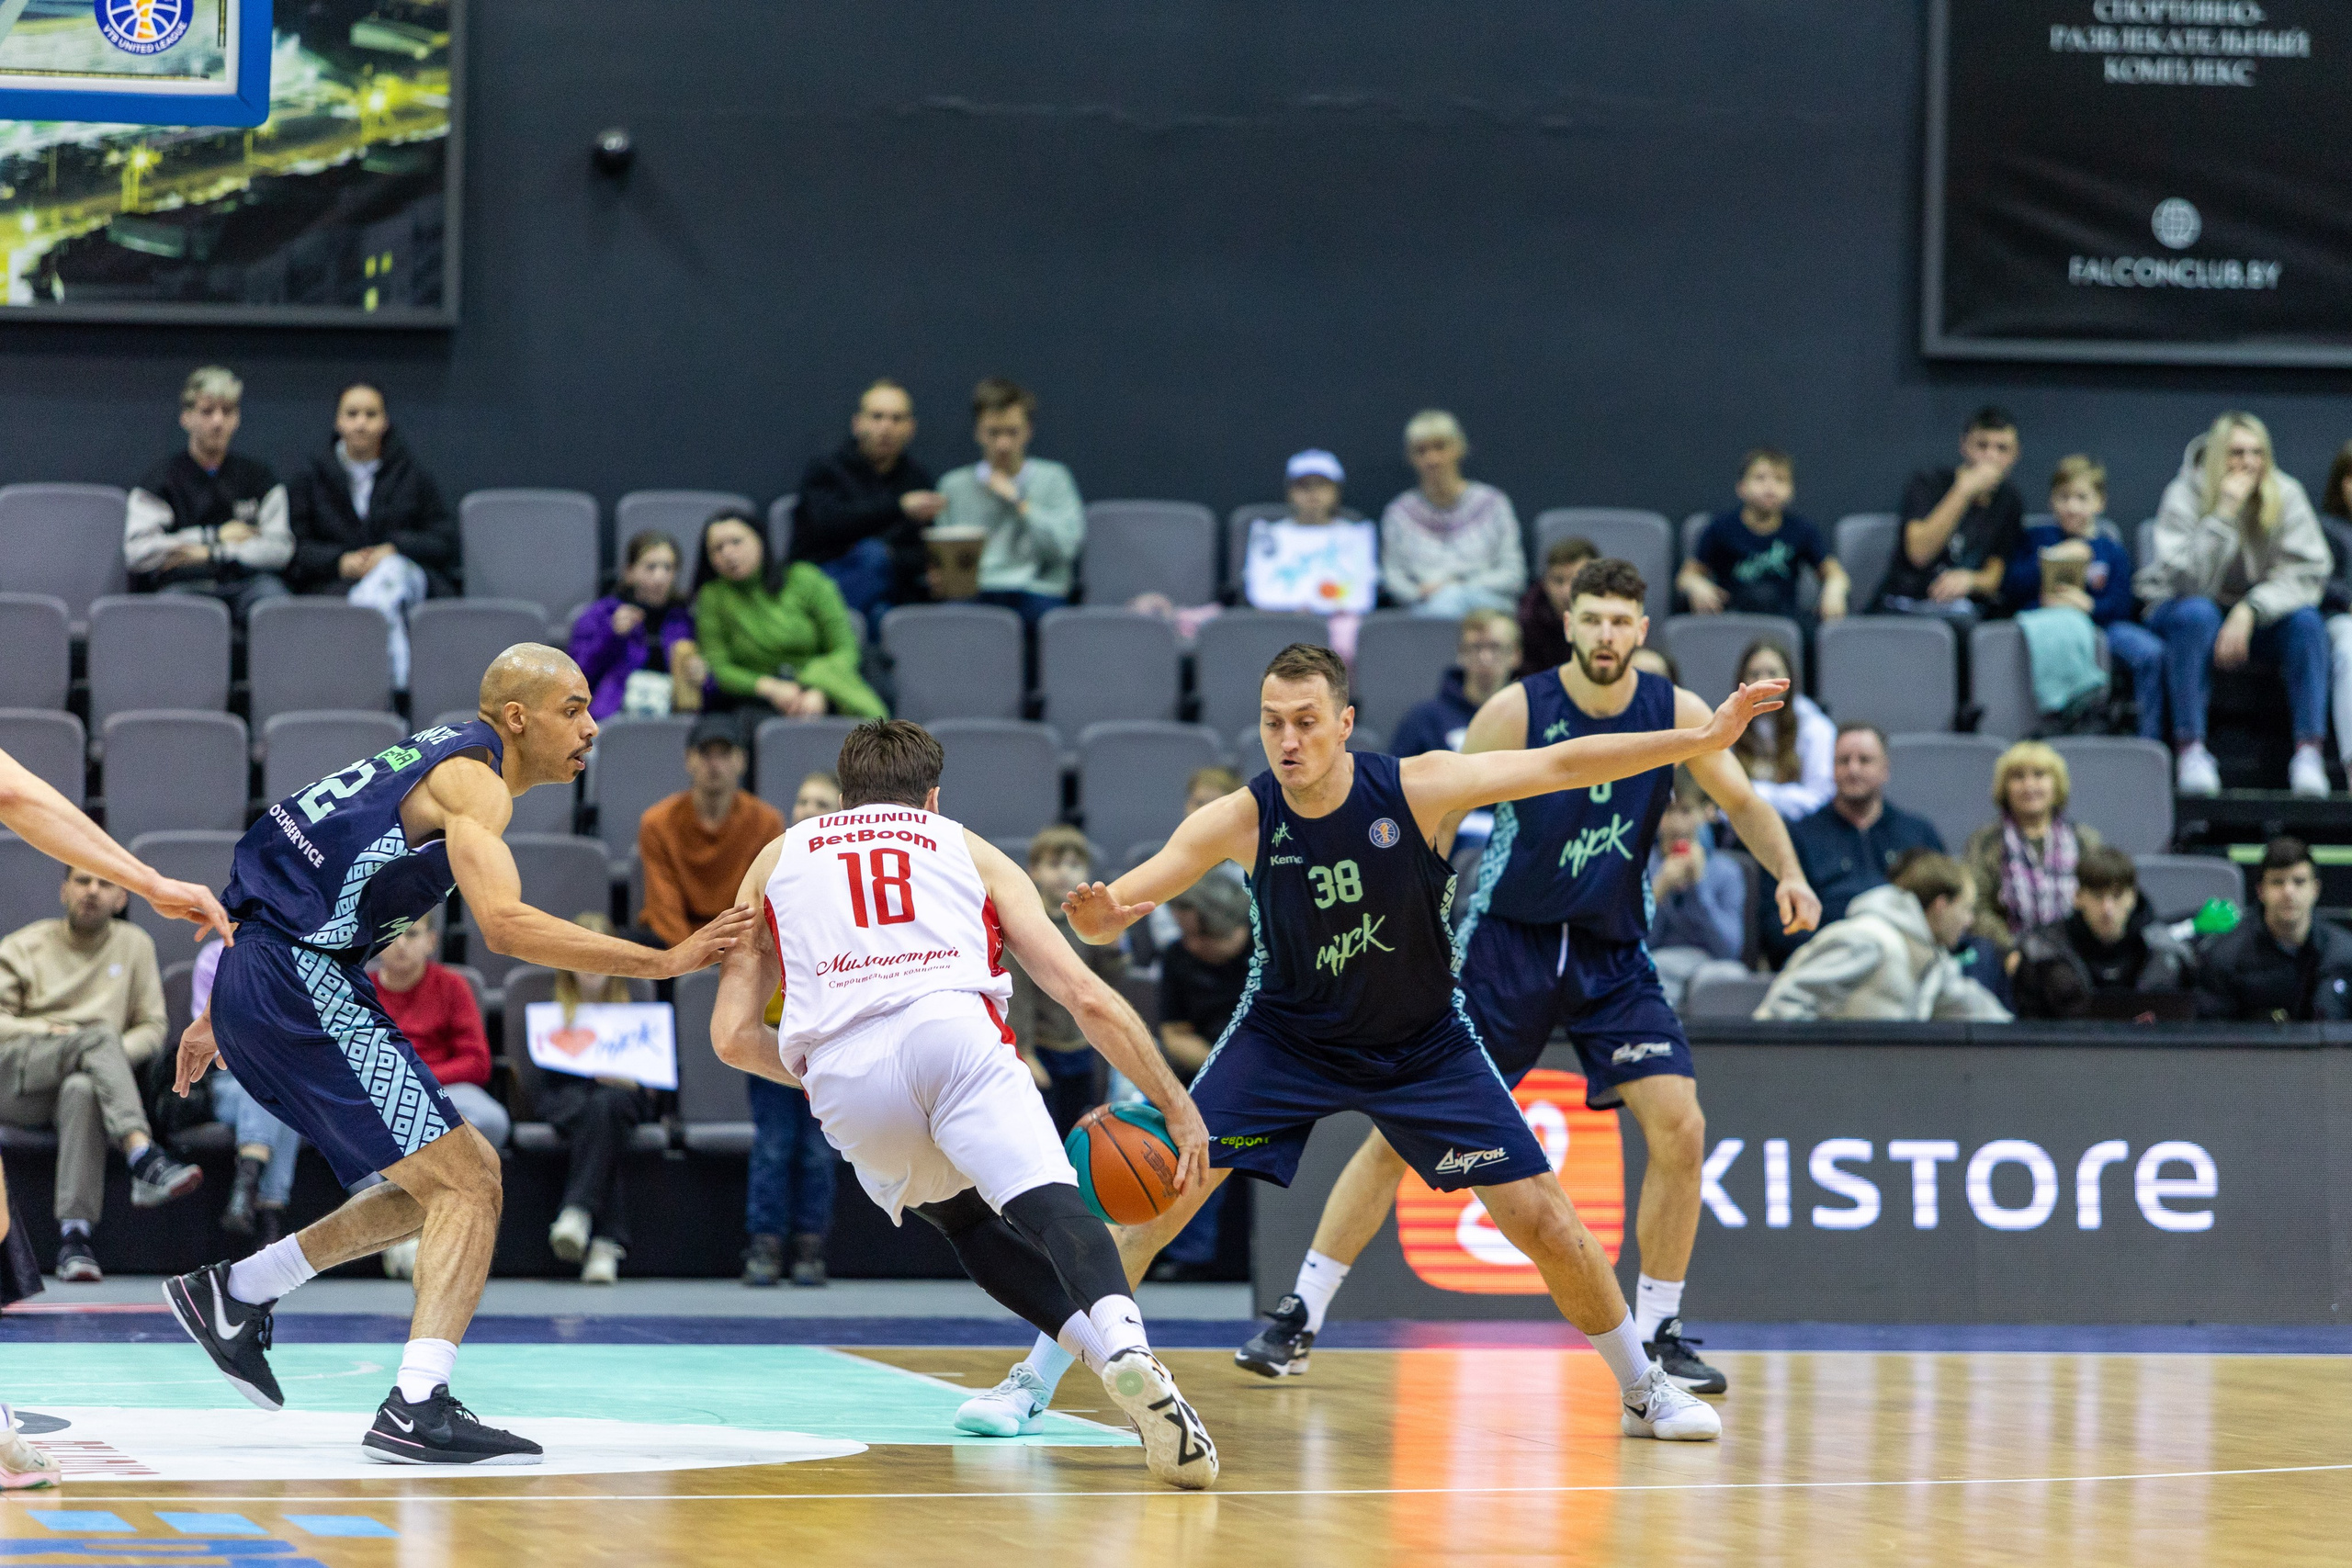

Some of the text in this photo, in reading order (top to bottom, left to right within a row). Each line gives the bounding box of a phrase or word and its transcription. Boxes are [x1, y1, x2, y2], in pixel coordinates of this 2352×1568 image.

[103, 20, 187, 54] VTB UNITED LEAGUE
[2050, 23, 2312, 58] РАЗВЛЕКАТЕЛЬНЫЙ
[2104, 55, 2257, 86] КОМПЛЕКС
[2068, 254, 2284, 290] FALCONCLUB.BY
[808, 829, 937, 853] BetBoom
[837, 848, 916, 929] 18
[1307, 859, 1364, 909] 38
[816, 946, 961, 976] Миланстрой
[829, 972, 900, 989] Строительная
